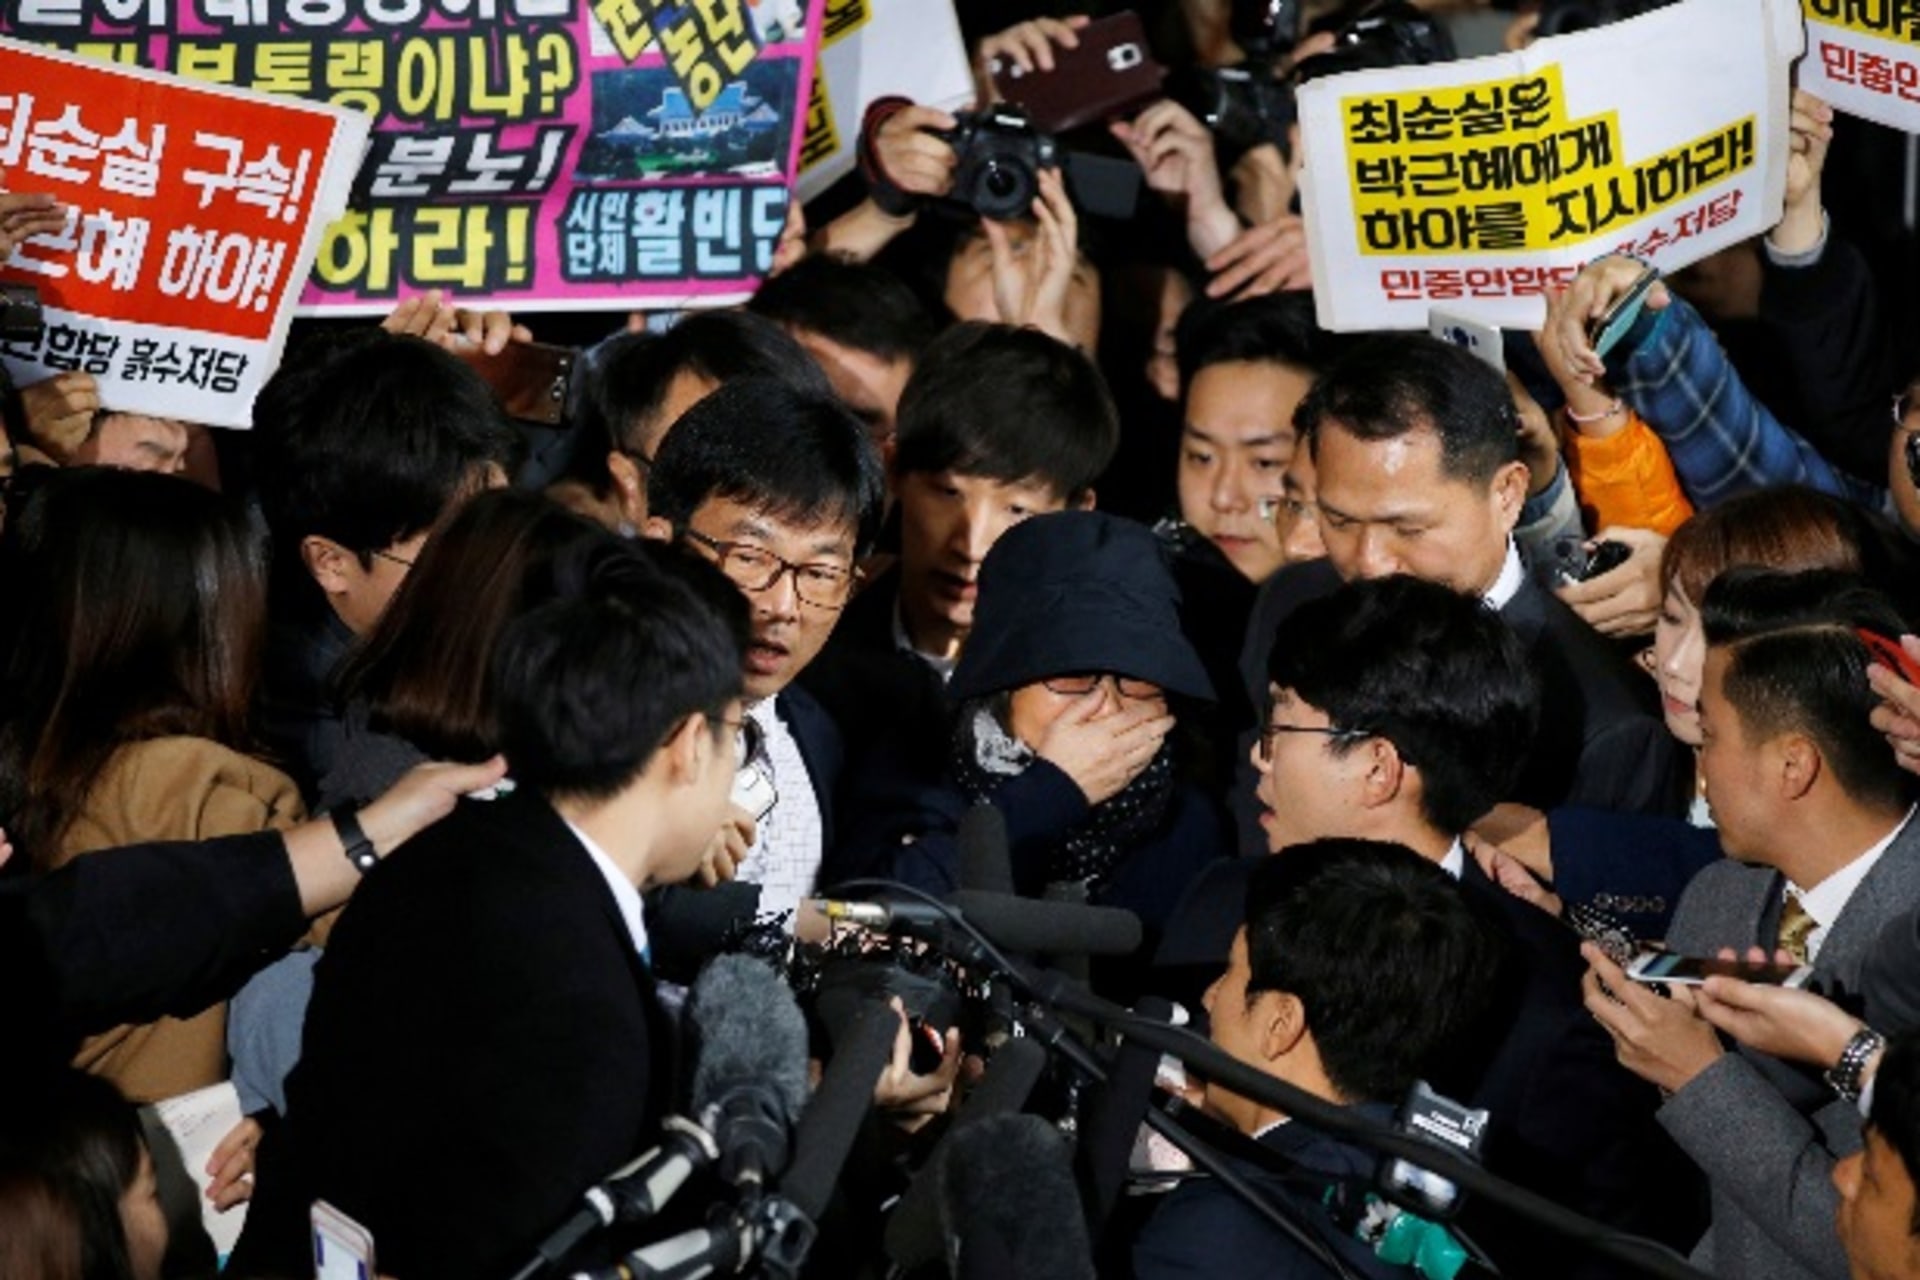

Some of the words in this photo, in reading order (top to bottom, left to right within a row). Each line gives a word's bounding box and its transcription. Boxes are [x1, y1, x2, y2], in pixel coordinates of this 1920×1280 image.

[183, 130, 312, 224] 구속!
[1356, 120, 1613, 197] 박근혜에게
[1361, 202, 1529, 250] 하야를
[1547, 120, 1754, 241] 지시하라!
[566, 191, 630, 232] 시민
[1614, 189, 1743, 256] 수저당
[158, 223, 287, 313] 하야!
[567, 232, 626, 275] 단체
[121, 338, 249, 394] 흙수저당
